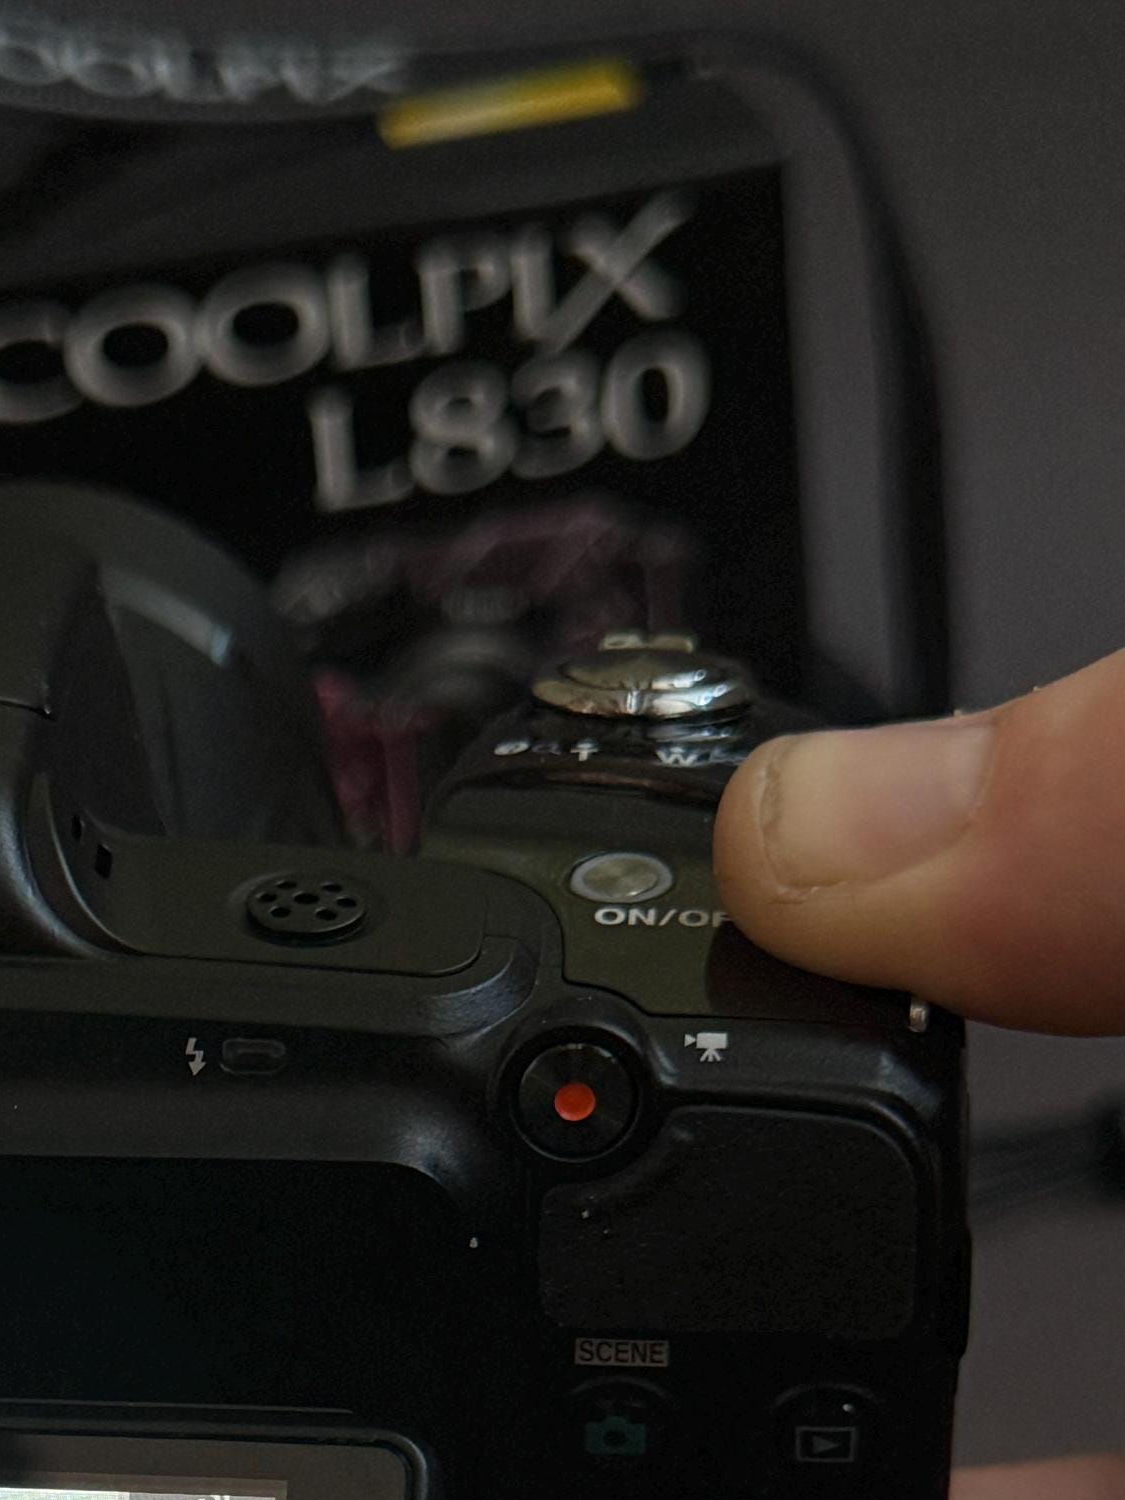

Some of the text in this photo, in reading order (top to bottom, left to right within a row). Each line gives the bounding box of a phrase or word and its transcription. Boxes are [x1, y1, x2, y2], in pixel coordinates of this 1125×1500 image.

[311, 328, 710, 511] L830
[594, 907, 733, 928] ON/OF
[578, 1340, 667, 1366] SCENE
